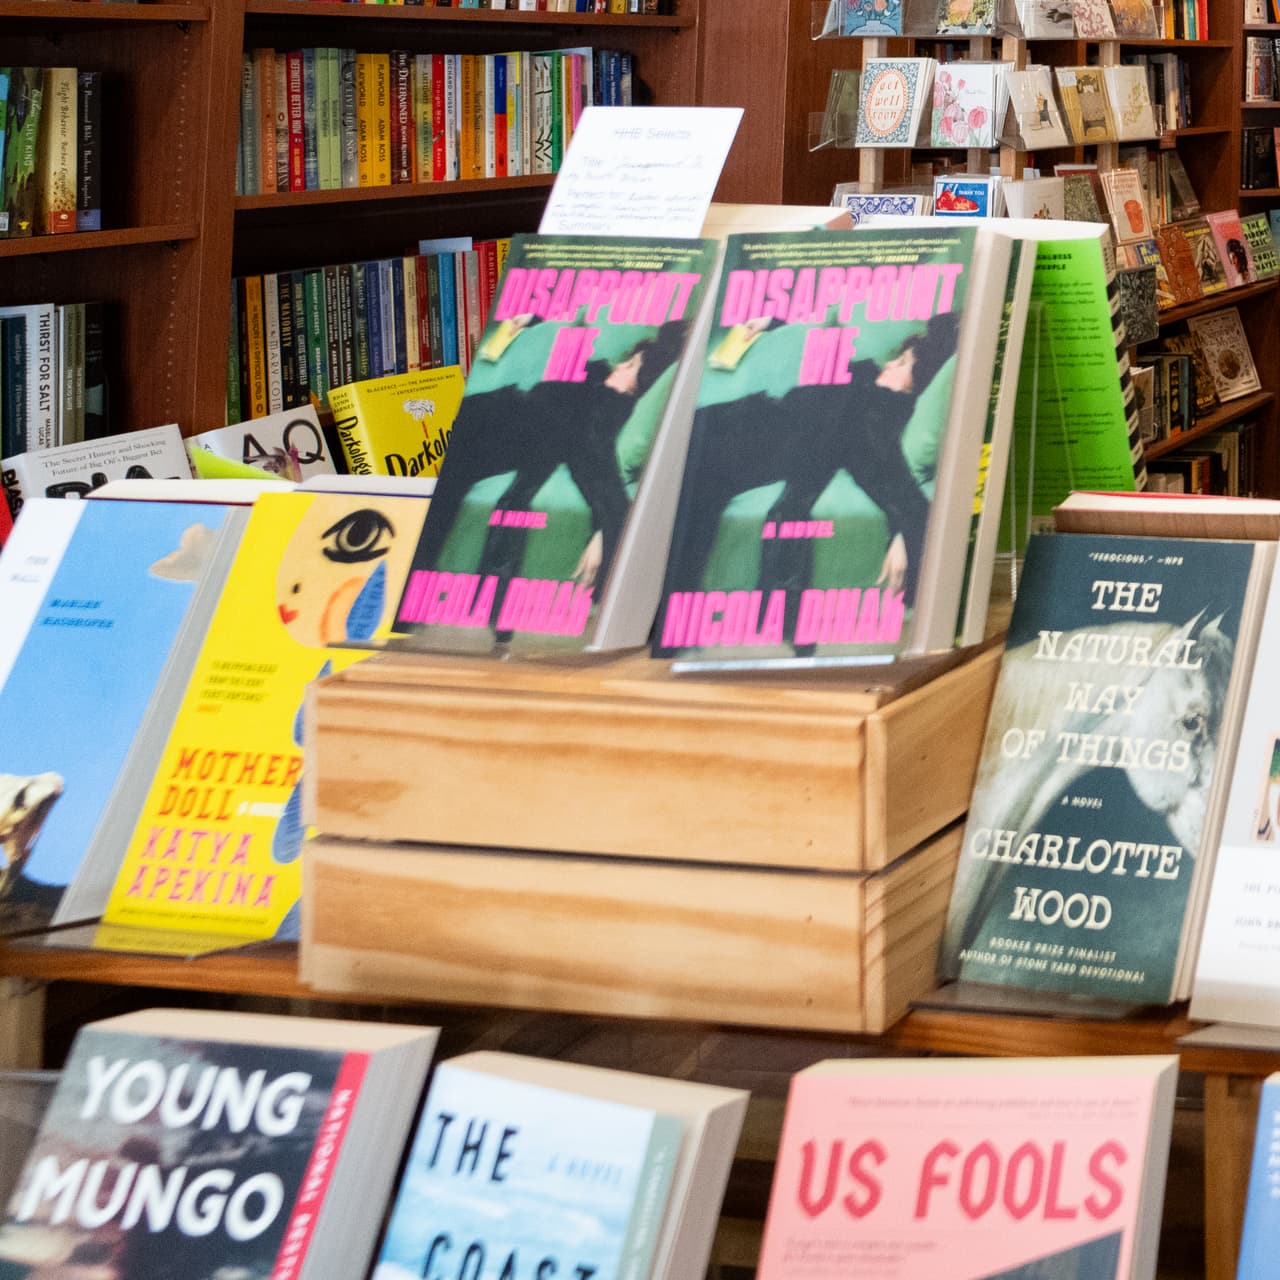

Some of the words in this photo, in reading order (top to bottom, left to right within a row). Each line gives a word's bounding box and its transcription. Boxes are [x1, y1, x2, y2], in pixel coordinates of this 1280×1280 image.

[493, 267, 701, 322] DISAPPOINT
[719, 263, 963, 327] DISAPPOINT
[40, 312, 50, 353] THIRST
[542, 326, 602, 382] ME
[40, 356, 50, 381] FOR
[798, 326, 860, 386] ME
[39, 385, 50, 412] SALT
[398, 569, 500, 629] NICOLA
[498, 576, 597, 636] DINAN
[661, 589, 787, 649] NICOLA
[795, 586, 907, 646] DINAN
[1089, 579, 1162, 614] THE
[1033, 630, 1202, 671] NATURAL
[1064, 682, 1144, 715] WAY
[171, 747, 303, 787] MOTHER
[1002, 727, 1048, 761] OF
[1053, 731, 1191, 773] THINGS
[157, 784, 235, 823] DOLL
[140, 826, 256, 865] KATYA
[970, 827, 1183, 881] CHARLOTTE
[126, 863, 273, 909] APEKINA
[1009, 887, 1113, 932] WOOD
[78, 1055, 312, 1138] YOUNG
[426, 1111, 521, 1184] THE
[16, 1155, 284, 1242] MUNGO
[796, 1139, 886, 1221] US
[913, 1137, 1130, 1222] FOOLS
